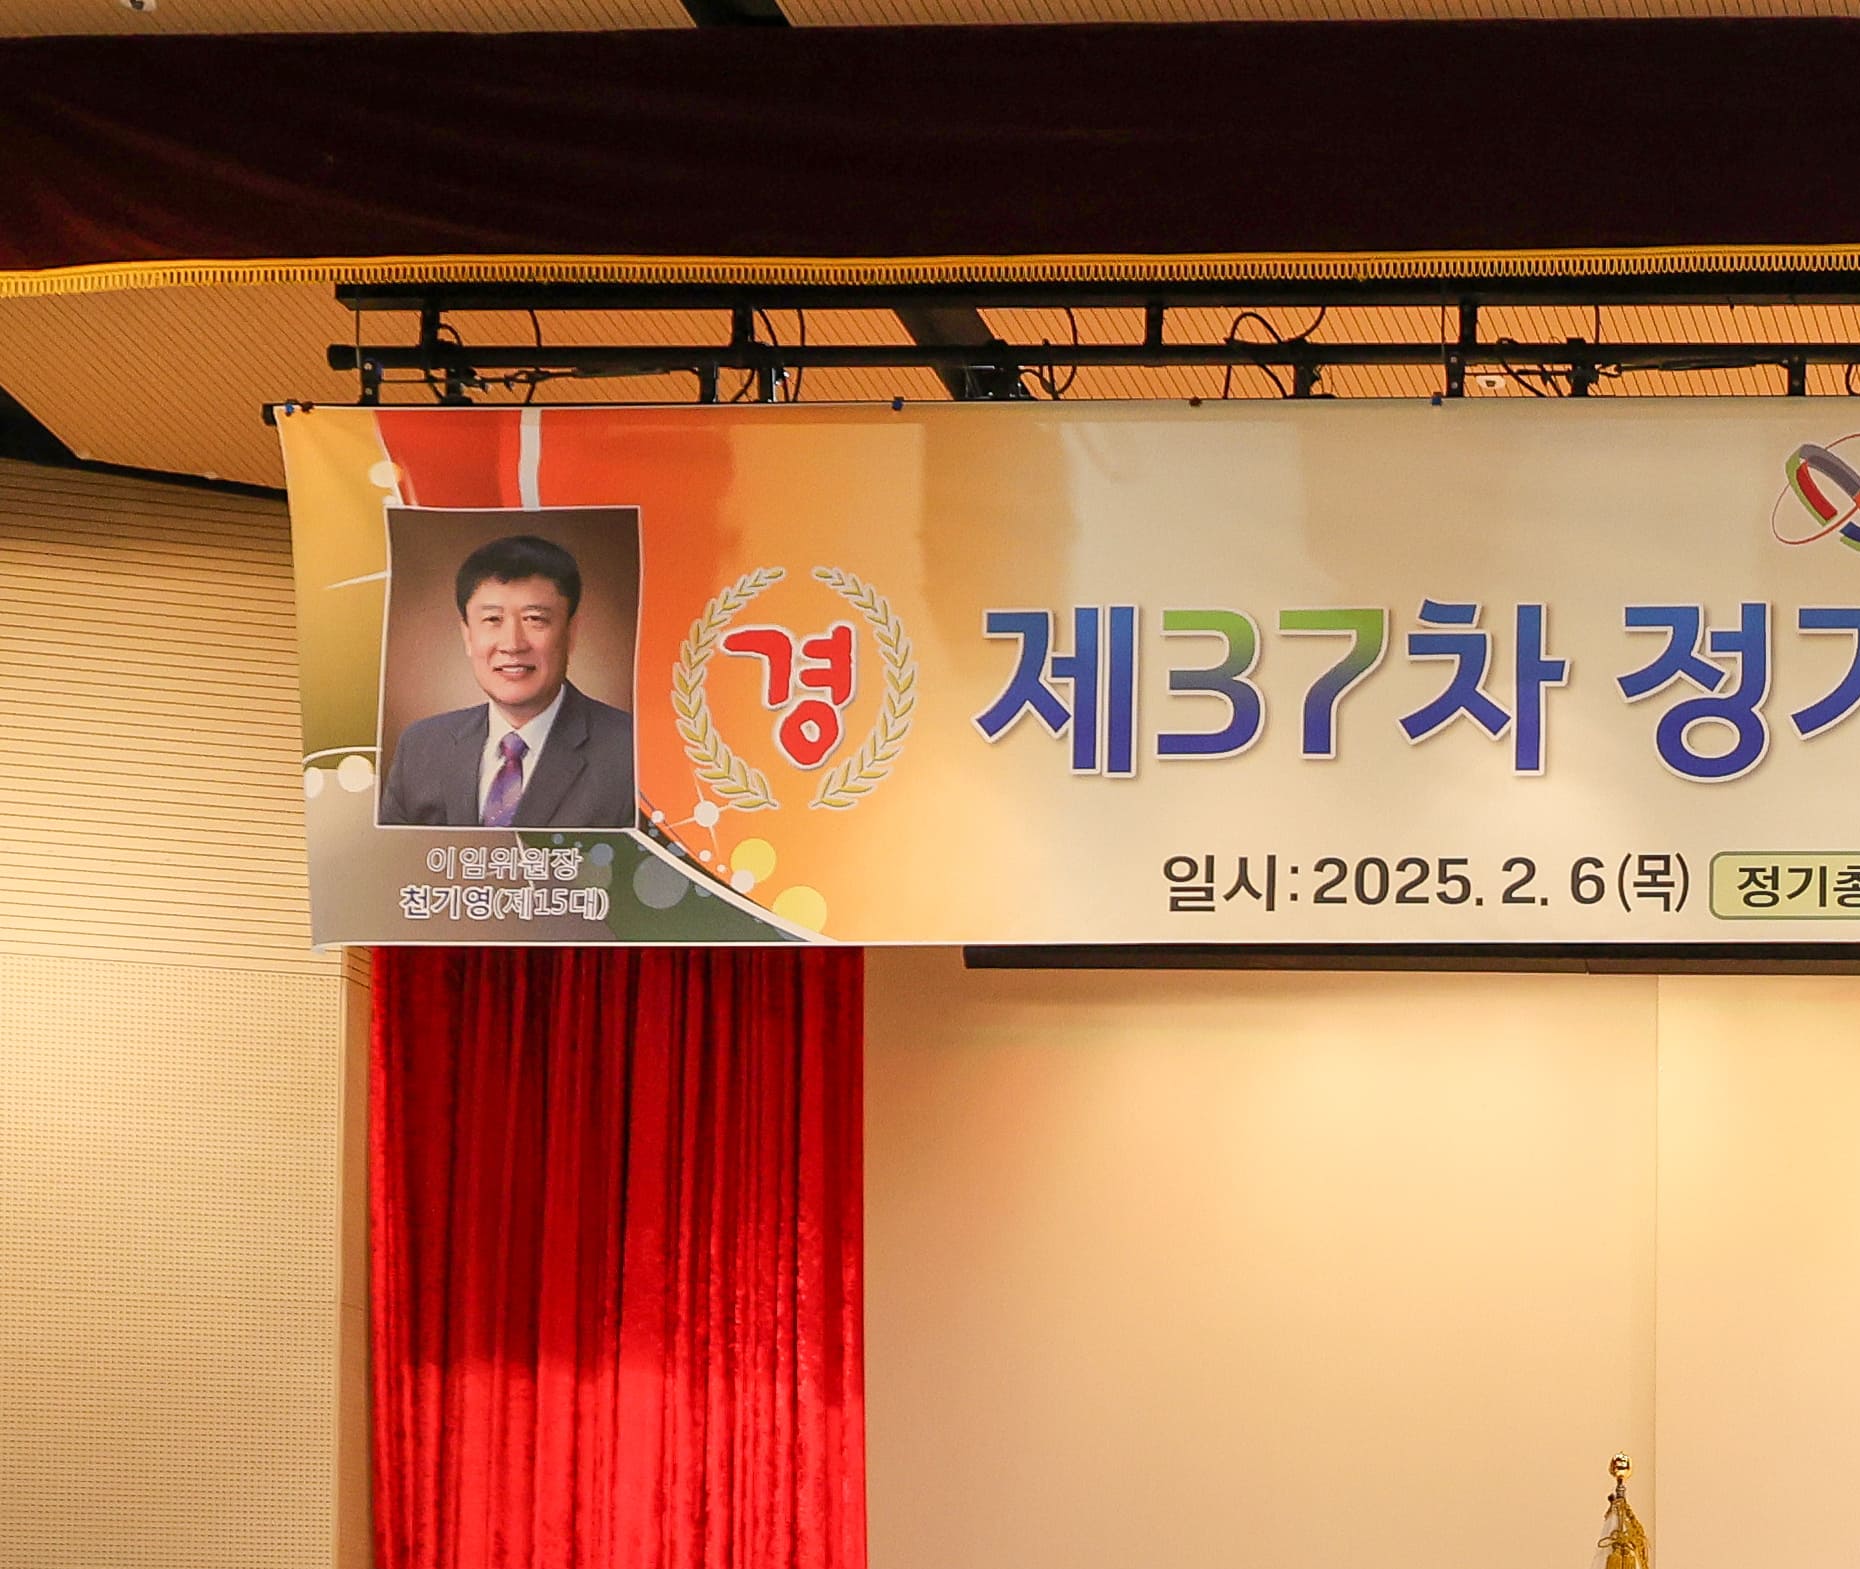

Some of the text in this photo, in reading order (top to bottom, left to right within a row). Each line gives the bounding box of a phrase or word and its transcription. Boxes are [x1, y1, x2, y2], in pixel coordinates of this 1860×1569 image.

[720, 622, 859, 770] 경
[972, 598, 1571, 778] 제37차
[399, 884, 610, 922] 천기영(제15대)
[426, 845, 584, 882] 이임위원장
